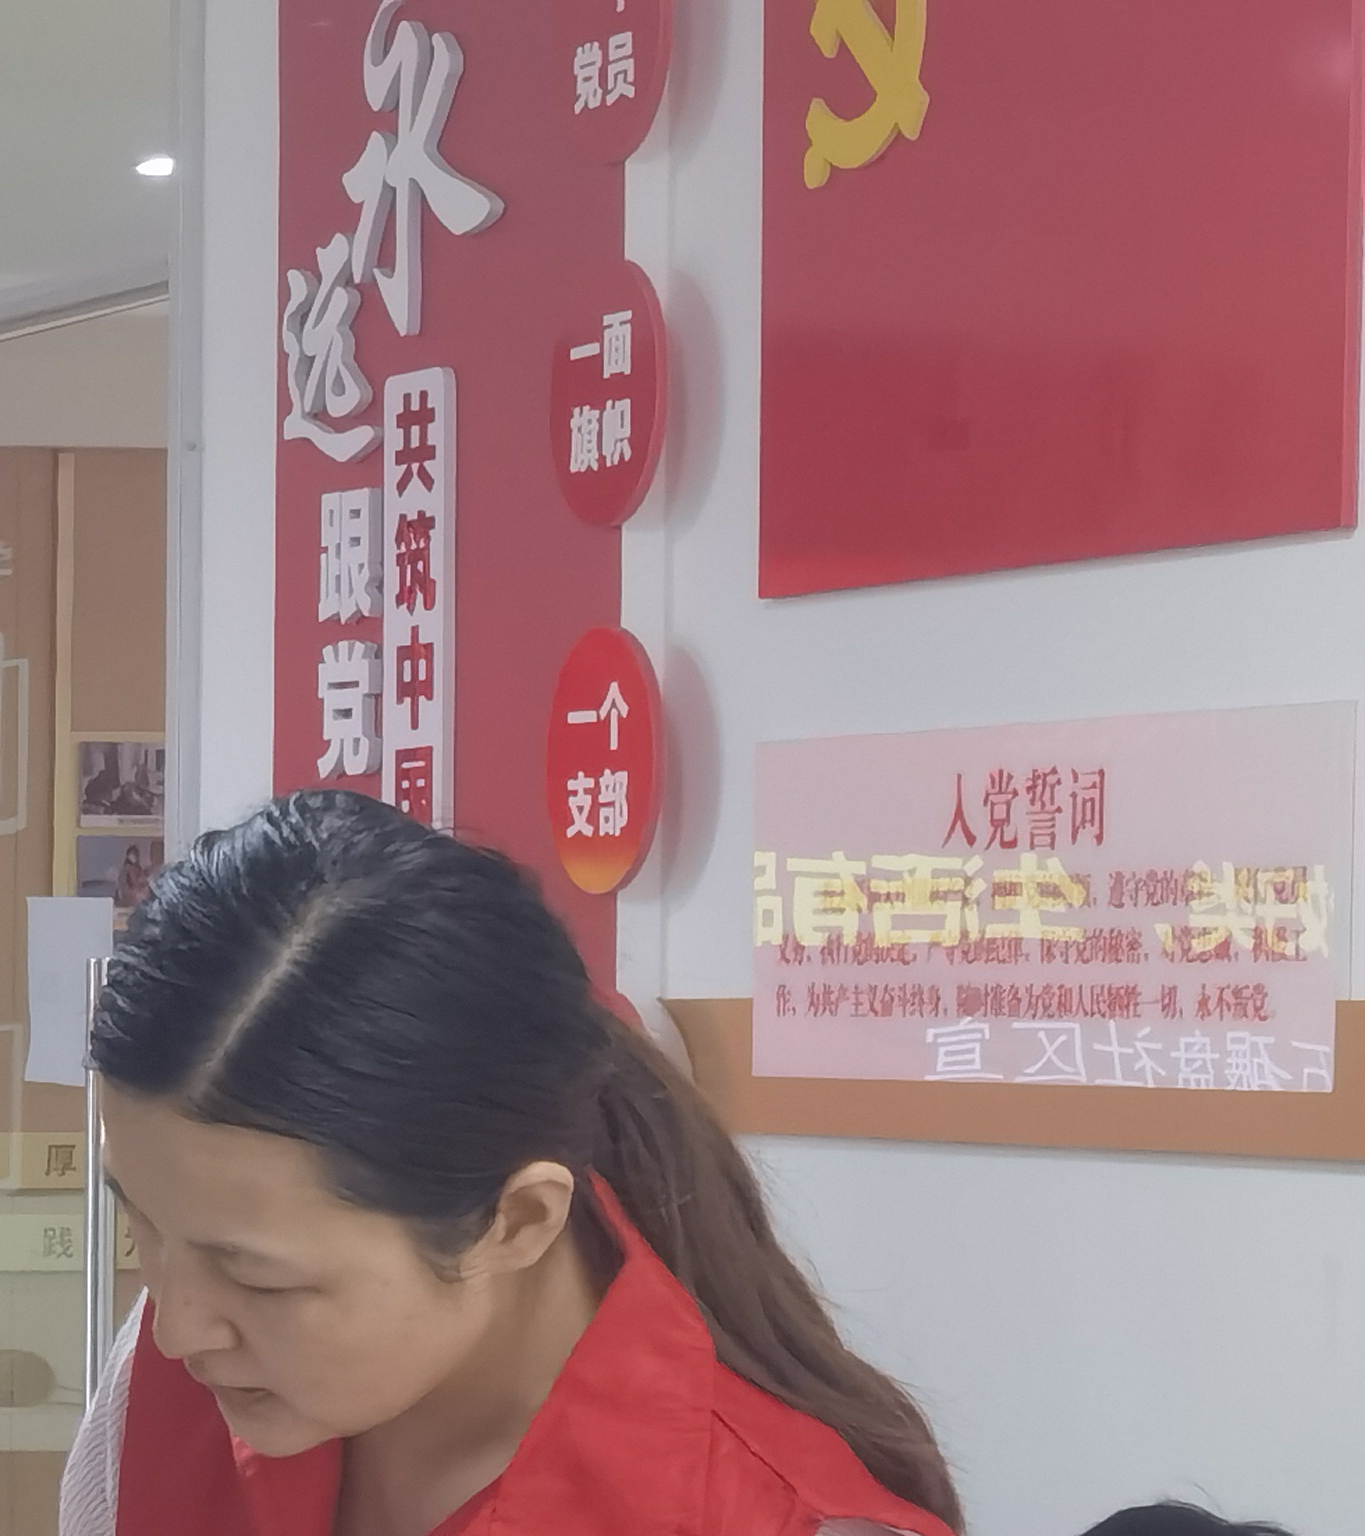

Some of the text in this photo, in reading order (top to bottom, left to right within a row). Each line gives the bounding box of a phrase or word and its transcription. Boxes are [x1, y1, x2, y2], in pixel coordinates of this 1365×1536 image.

[573, 31, 636, 115] 党员
[568, 310, 633, 381] 一面
[568, 398, 632, 474] 旗帜
[566, 679, 630, 752] 一个
[566, 768, 629, 840] 支部
[44, 1144, 77, 1177] 厚
